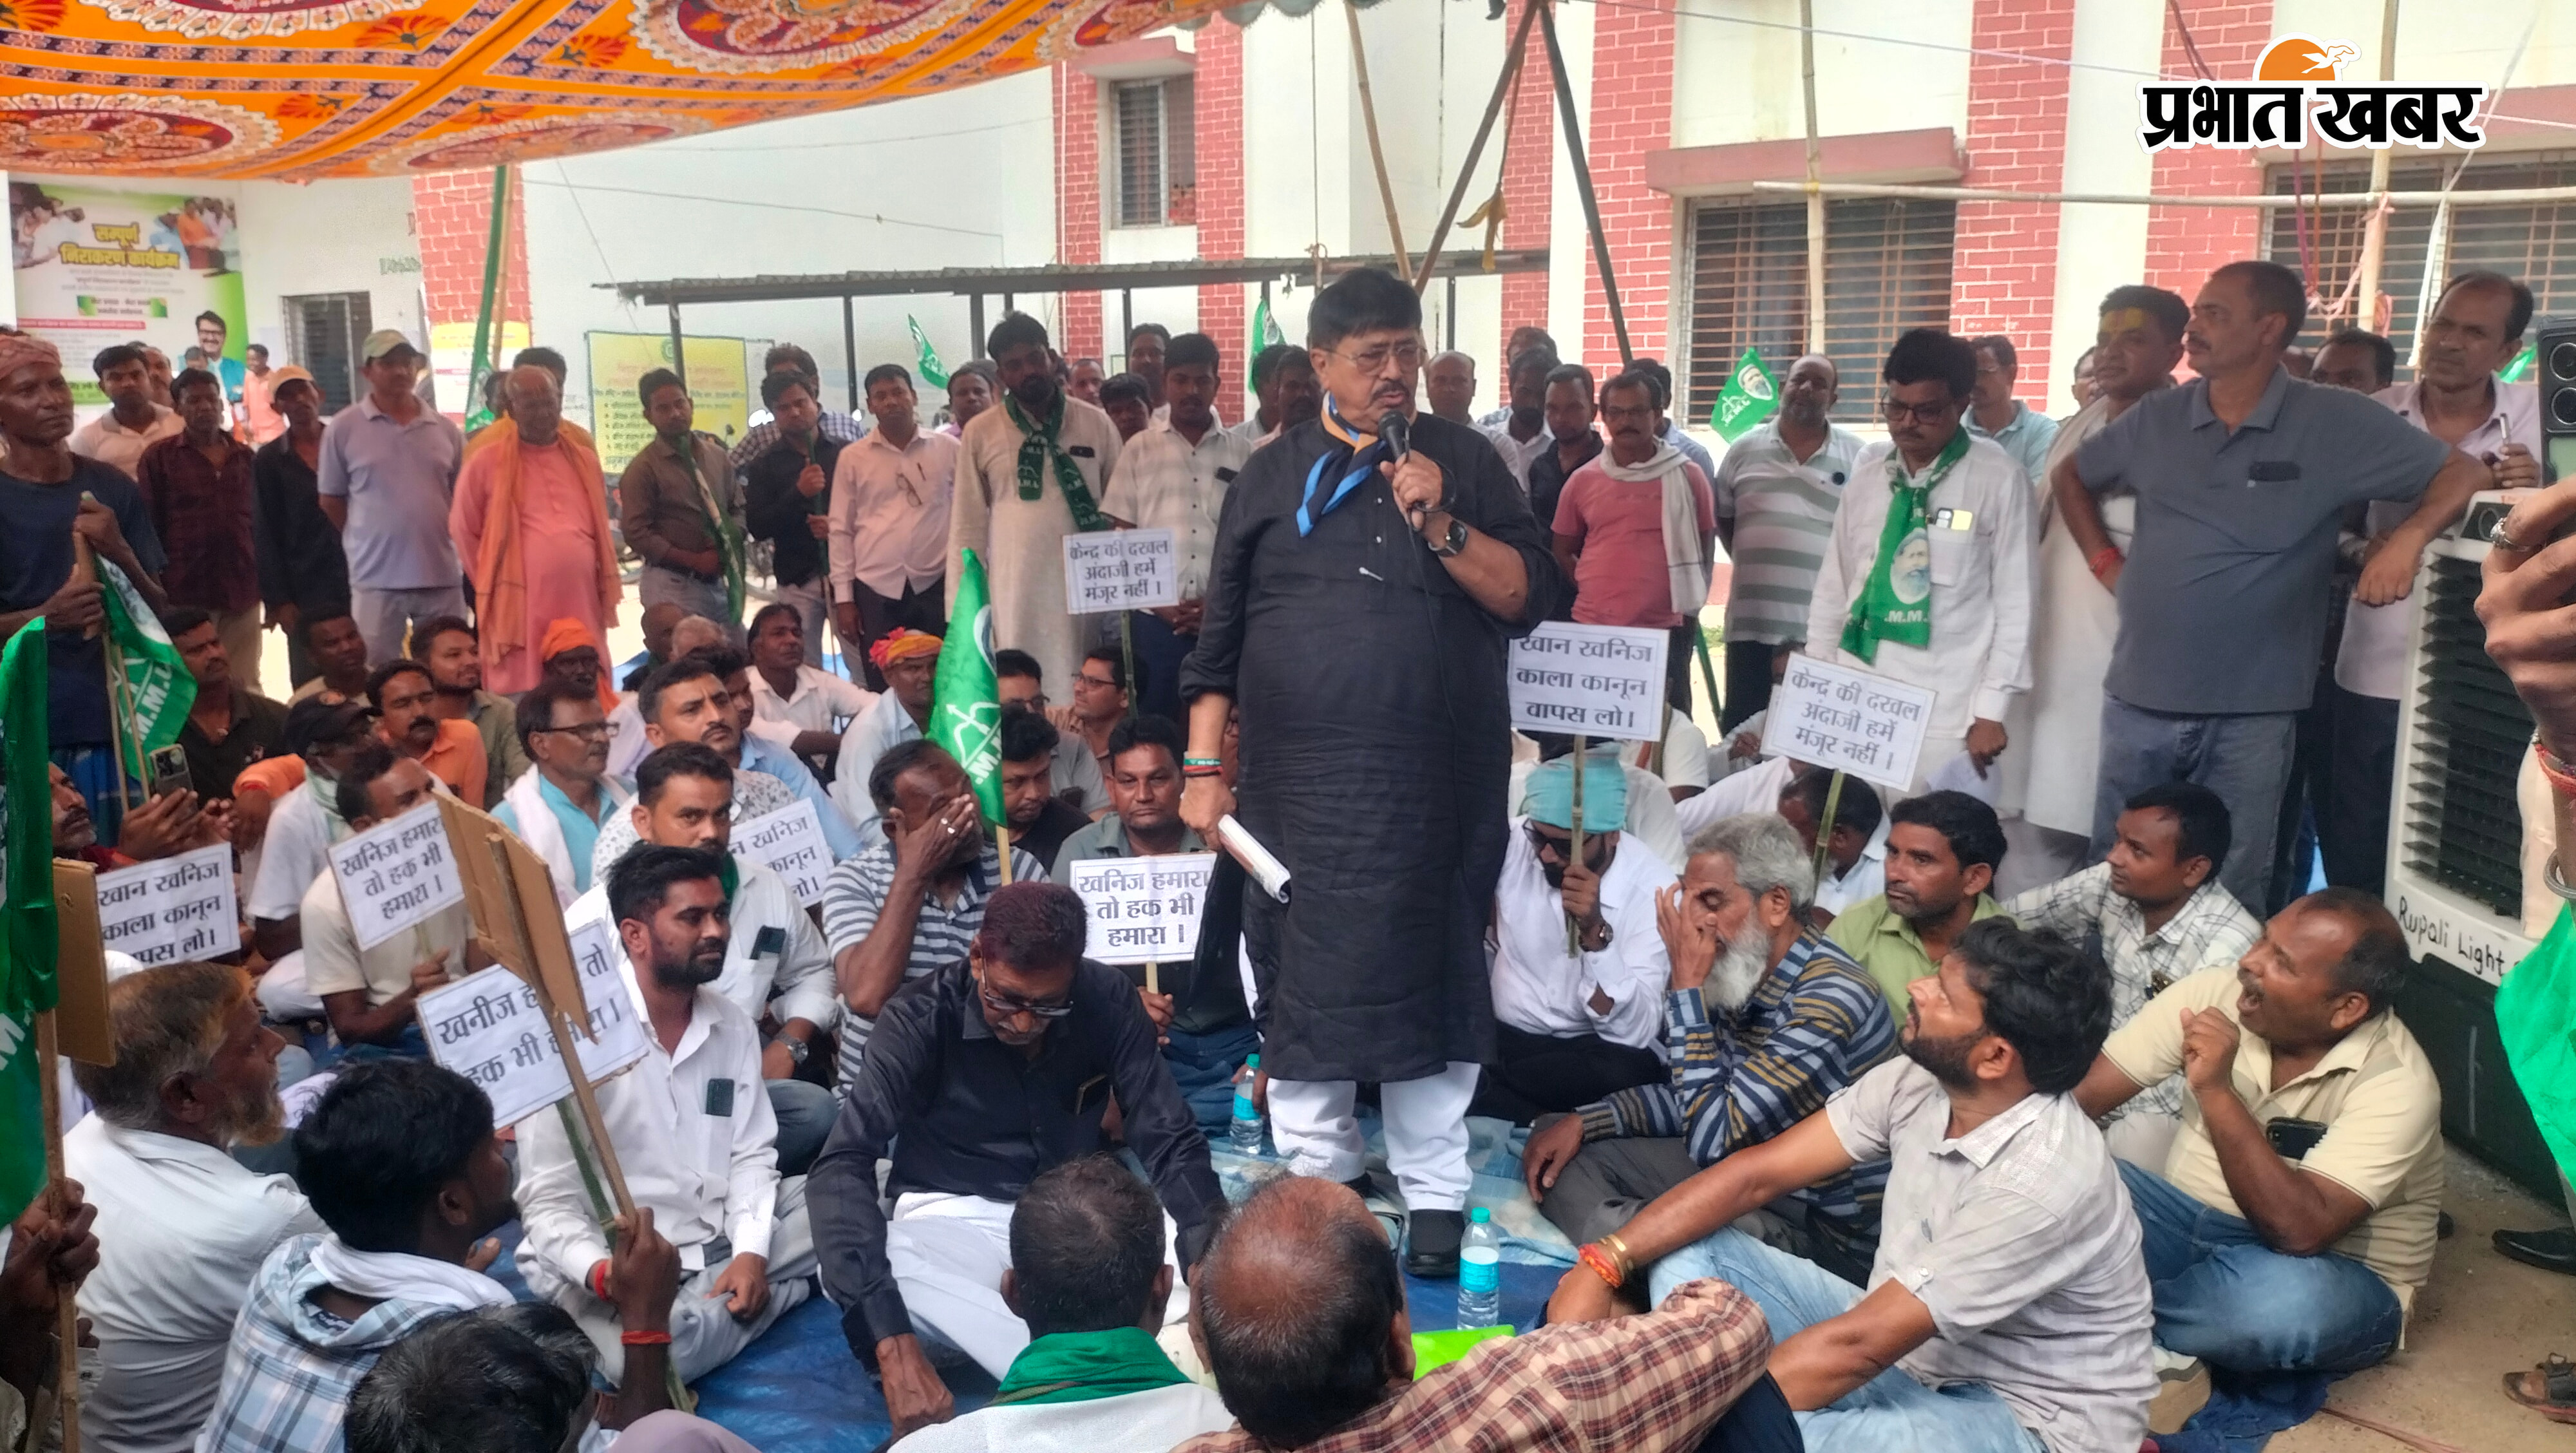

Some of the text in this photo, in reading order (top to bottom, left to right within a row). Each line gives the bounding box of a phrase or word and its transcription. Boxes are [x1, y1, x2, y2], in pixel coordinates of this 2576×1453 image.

[1070, 540, 1168, 560] केन्द्र की दखल
[1085, 562, 1129, 580] अंदाजी
[1085, 582, 1118, 603] मंजूर
[1123, 579, 1148, 597] नहीं
[1519, 636, 1653, 662] खान खनिज
[1516, 667, 1647, 701] काला कानून
[1792, 667, 1922, 721] केन्द्र की दखल
[1526, 701, 1587, 723] वापस
[1801, 698, 1899, 742] अंदाजी हमें
[1795, 723, 1839, 757] मंजूर
[1842, 740, 1880, 764] नहीं
[749, 816, 809, 849] खनिज
[339, 840, 399, 877] खनिज
[363, 841, 443, 896] तो हक भी
[99, 862, 220, 907] खान खनिज
[1077, 869, 1211, 893] खनिज हमारा
[102, 895, 221, 940] काला कानून
[381, 882, 430, 920] हमारा
[1096, 891, 1195, 919] तो हक भी
[1107, 926, 1166, 947] हमारा
[2399, 895, 2505, 976] Rupali Light
[582, 943, 609, 977] तो
[509, 1032, 544, 1068] भी
